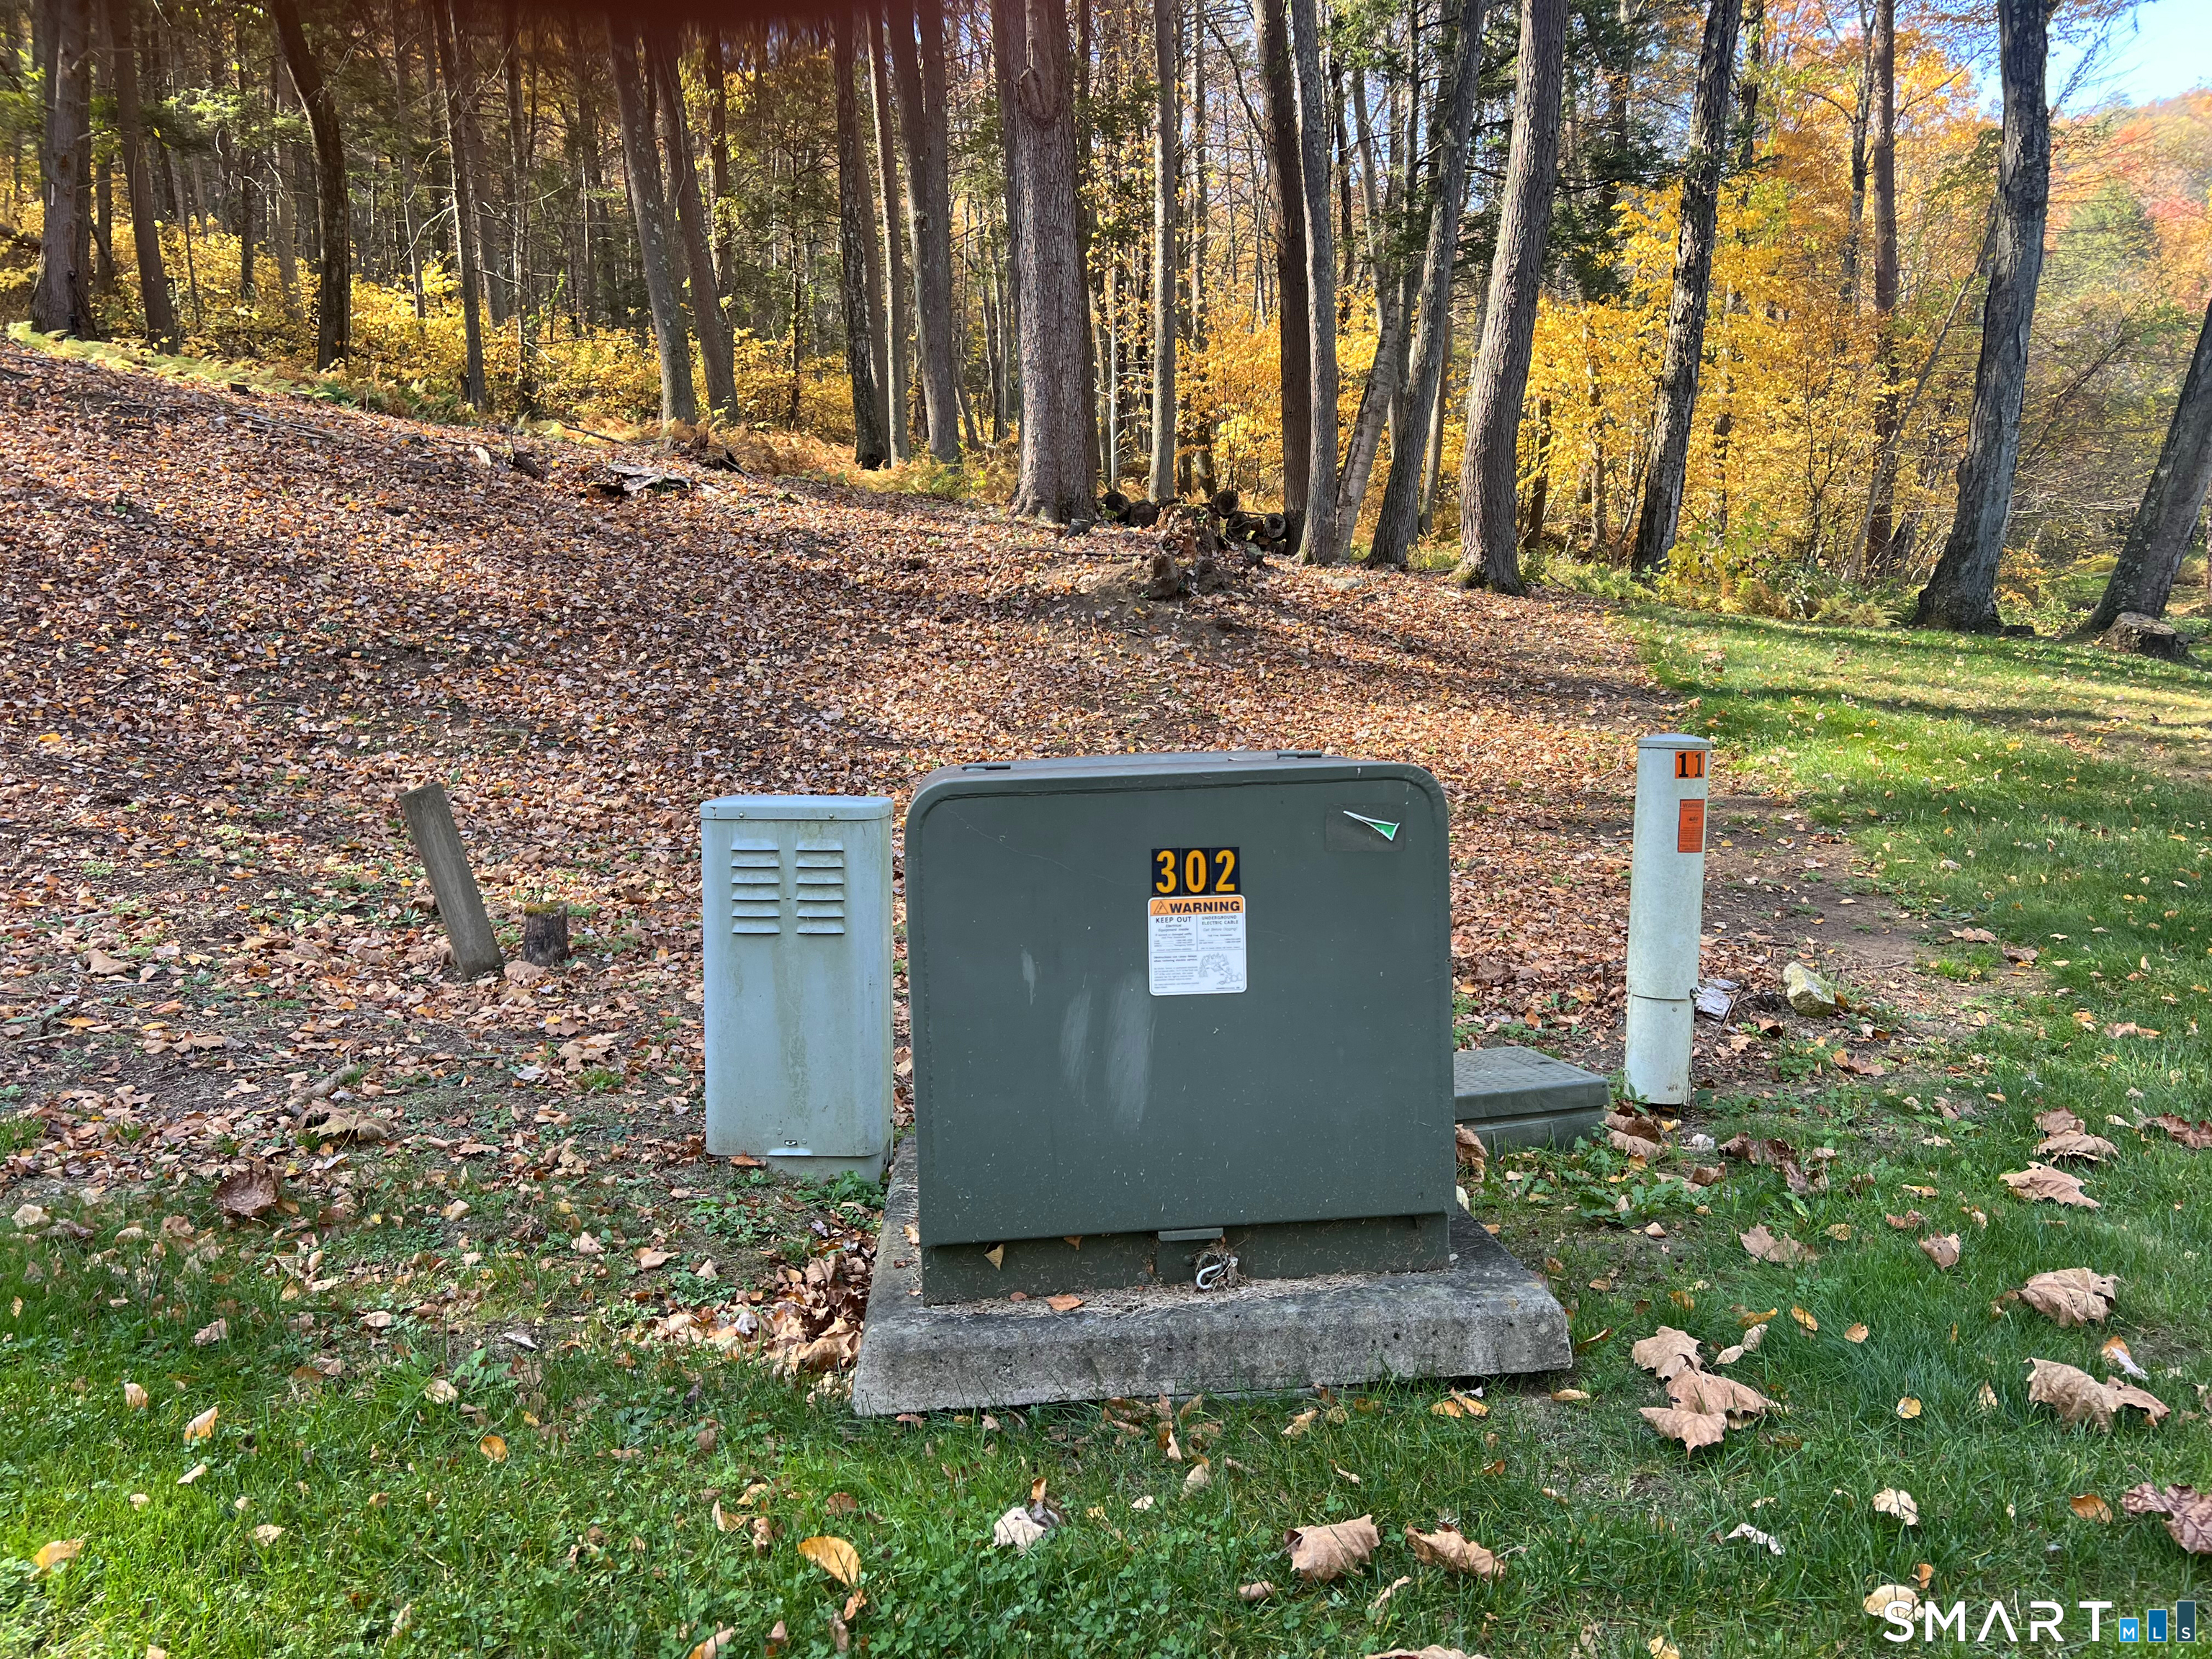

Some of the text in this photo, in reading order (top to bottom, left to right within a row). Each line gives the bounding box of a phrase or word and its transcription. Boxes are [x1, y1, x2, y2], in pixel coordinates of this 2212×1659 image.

[1678, 752, 1703, 778] 11
[1156, 850, 1236, 894] 302
[1169, 901, 1241, 914] WARNING
